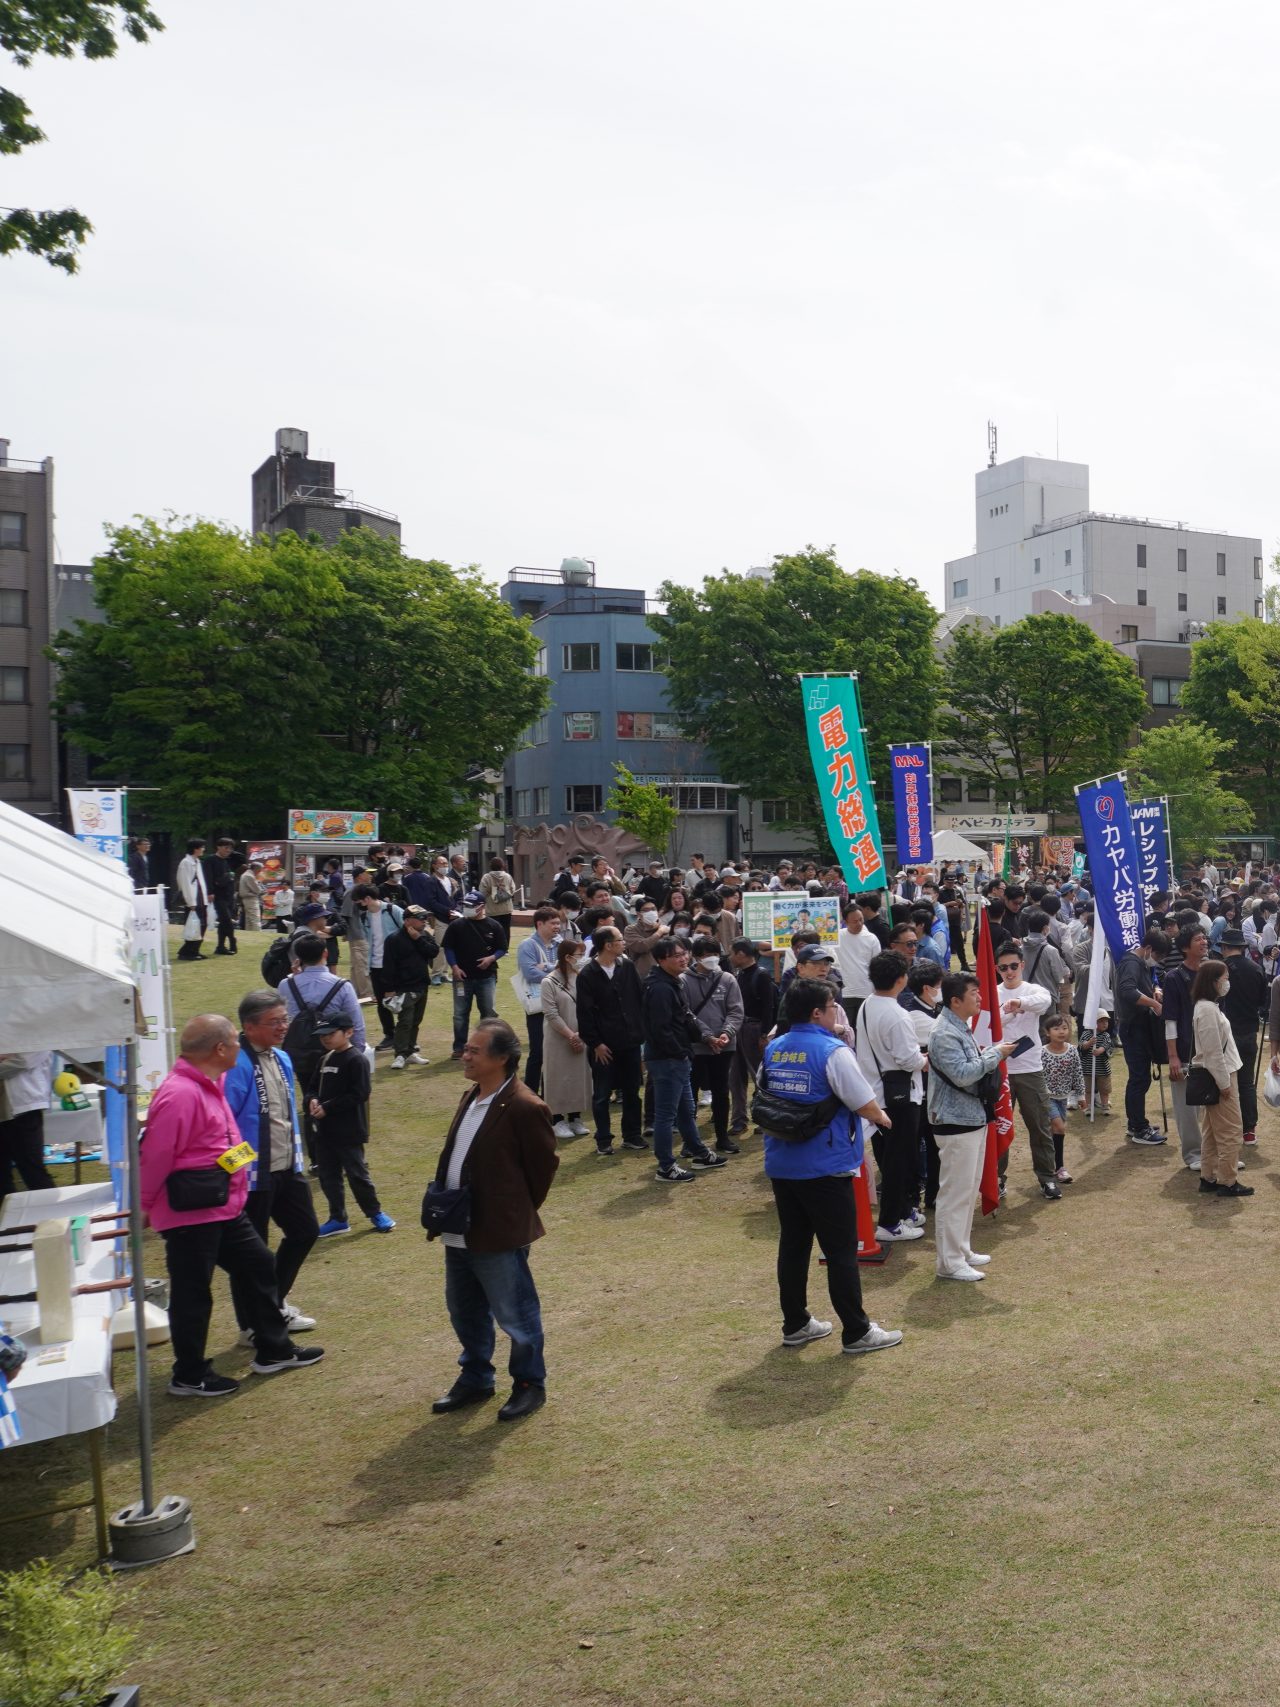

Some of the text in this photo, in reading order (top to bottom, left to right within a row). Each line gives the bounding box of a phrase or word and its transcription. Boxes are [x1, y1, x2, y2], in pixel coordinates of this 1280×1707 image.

[819, 704, 882, 884] 電力総連
[1131, 807, 1154, 820] JAM
